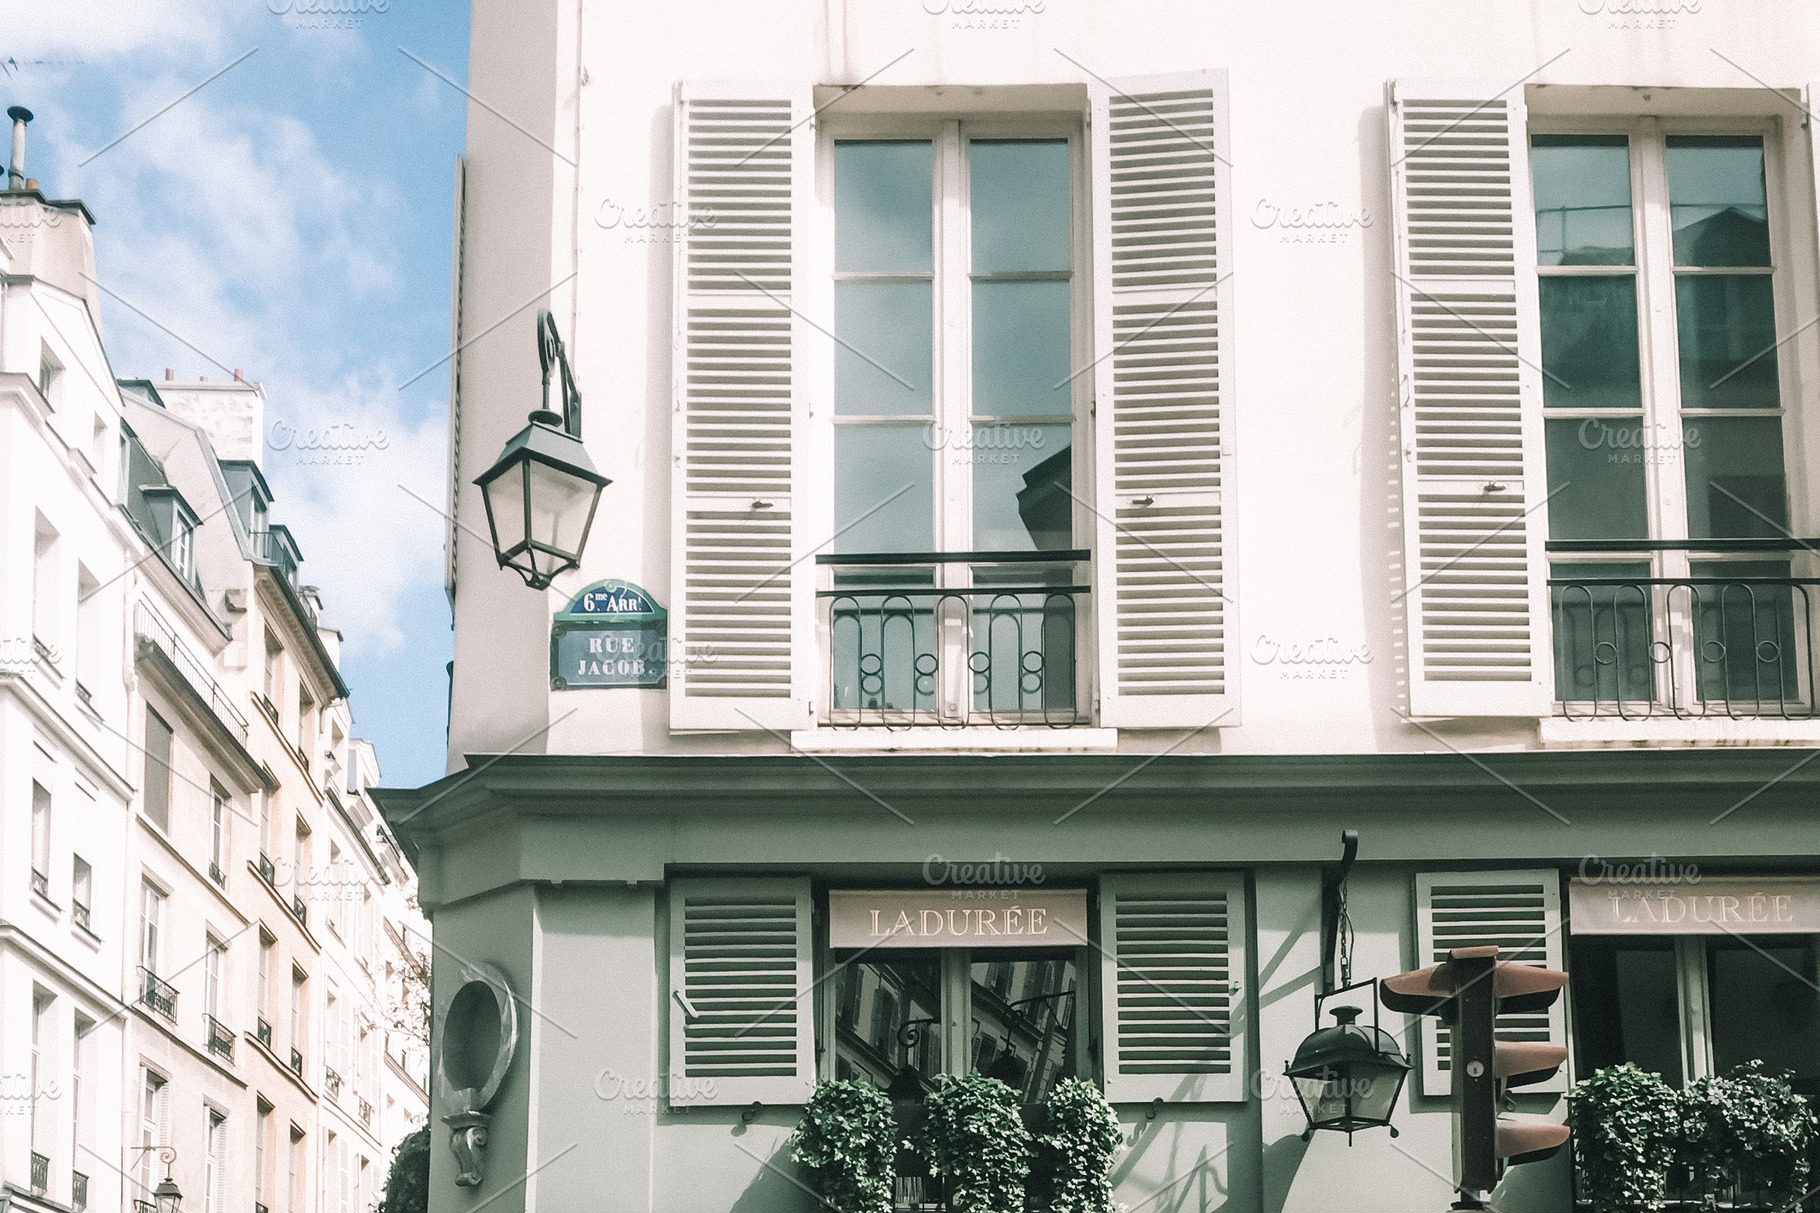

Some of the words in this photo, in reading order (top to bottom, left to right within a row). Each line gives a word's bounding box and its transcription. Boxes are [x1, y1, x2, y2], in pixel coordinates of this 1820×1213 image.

[589, 637, 634, 653] RUE
[869, 905, 1048, 936] LADURÉE
[1612, 891, 1793, 923] LADURÉE
